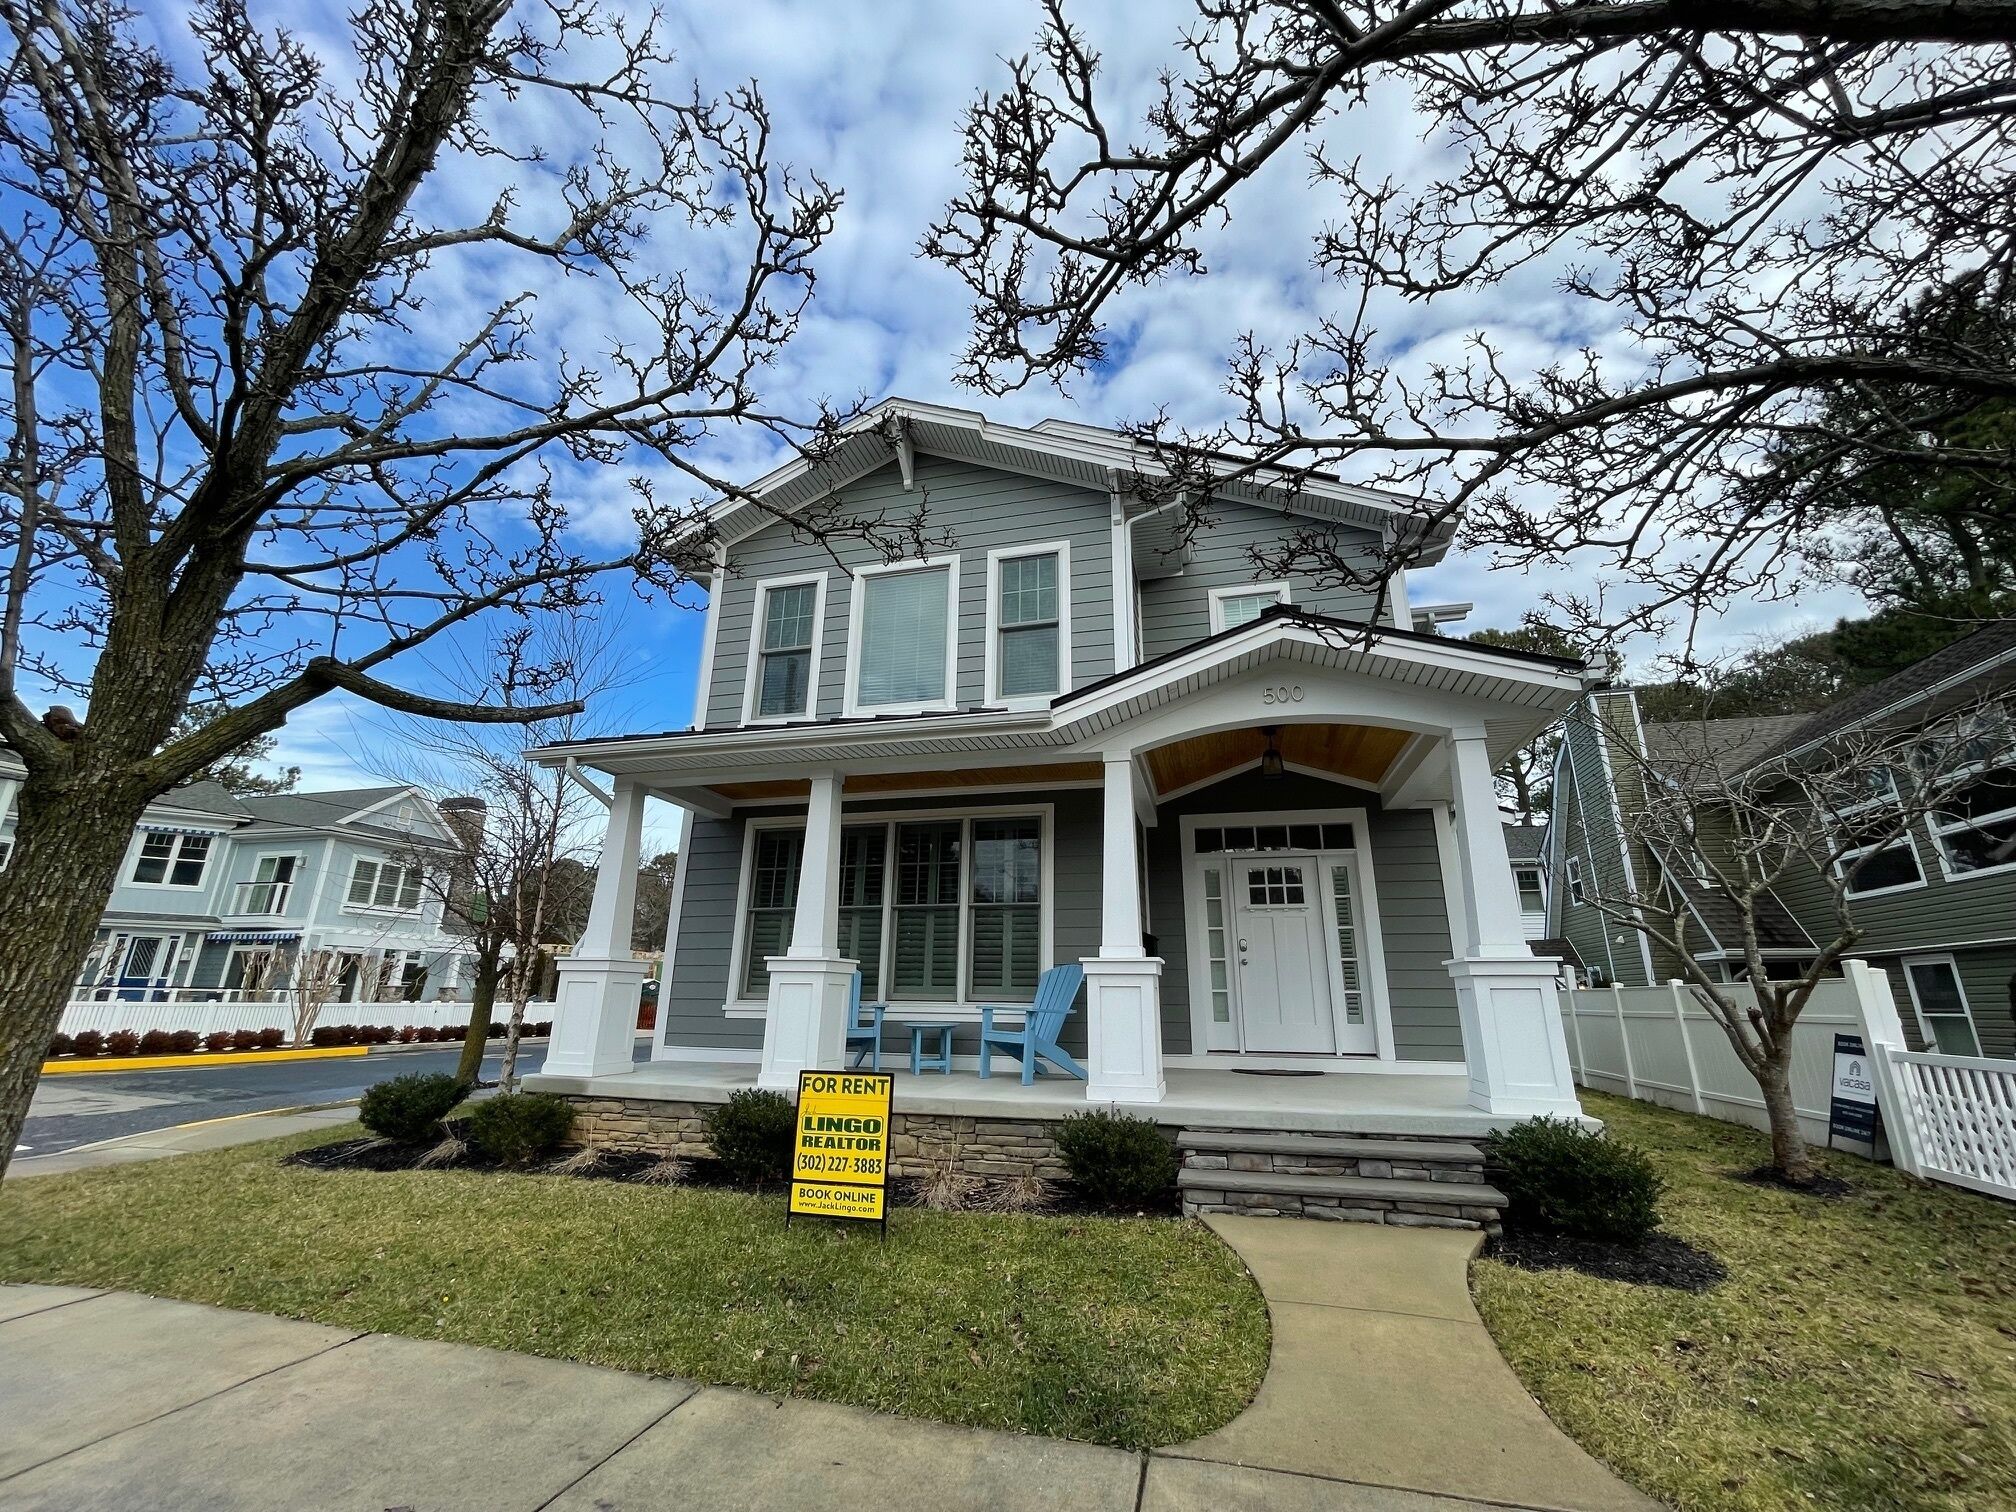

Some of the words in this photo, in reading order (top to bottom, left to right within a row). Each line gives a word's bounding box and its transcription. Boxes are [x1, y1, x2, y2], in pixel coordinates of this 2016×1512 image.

[1264, 686, 1304, 705] 500
[802, 1076, 837, 1094] FOR
[842, 1078, 889, 1095] RENT
[1839, 1078, 1871, 1091] vacasa
[804, 1116, 881, 1134] LINGO
[801, 1136, 881, 1151] REALTOR
[797, 1152, 826, 1173] (302)
[827, 1156, 882, 1174] 227-3883
[799, 1188, 831, 1200] BOOK
[834, 1191, 876, 1203] ONLINE
[798, 1201, 875, 1213] www.JackLingo.com
